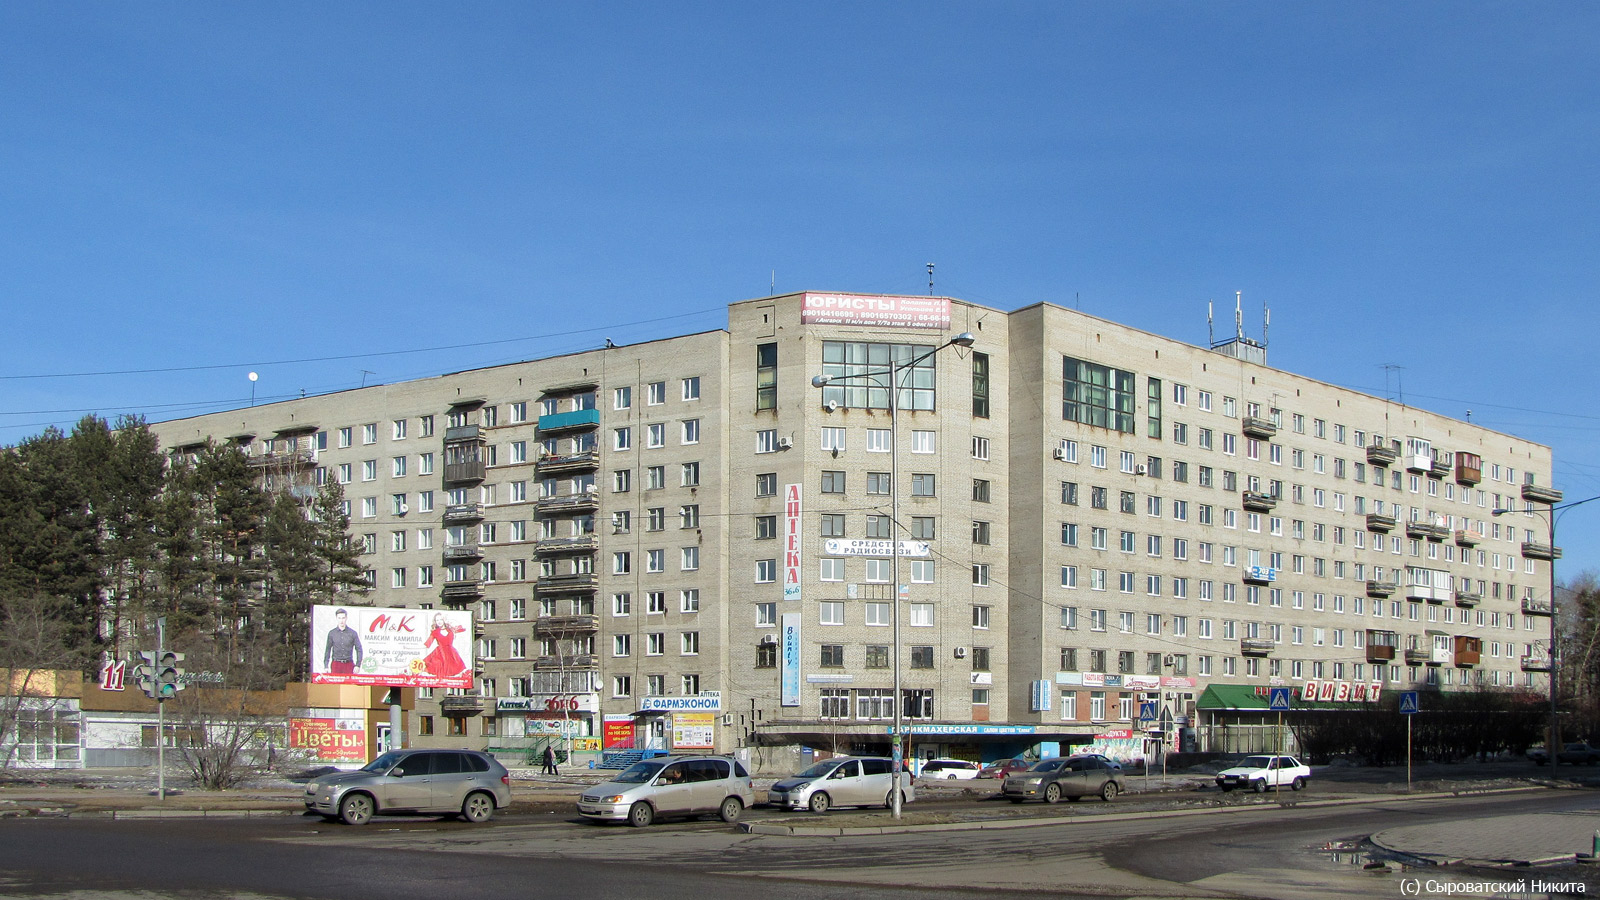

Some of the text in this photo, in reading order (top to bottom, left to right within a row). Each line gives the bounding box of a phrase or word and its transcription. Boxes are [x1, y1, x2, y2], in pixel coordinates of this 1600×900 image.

[805, 296, 895, 310] ЮРИСТЫ
[786, 486, 799, 584] АПТЕКА
[852, 540, 905, 548] СРЕДСТА
[364, 634, 390, 642] МАКСИМ
[1305, 683, 1380, 698] ВИЗИТ
[653, 700, 719, 708] ФАРМЭКОНОМ
[298, 730, 357, 747] Цветы
